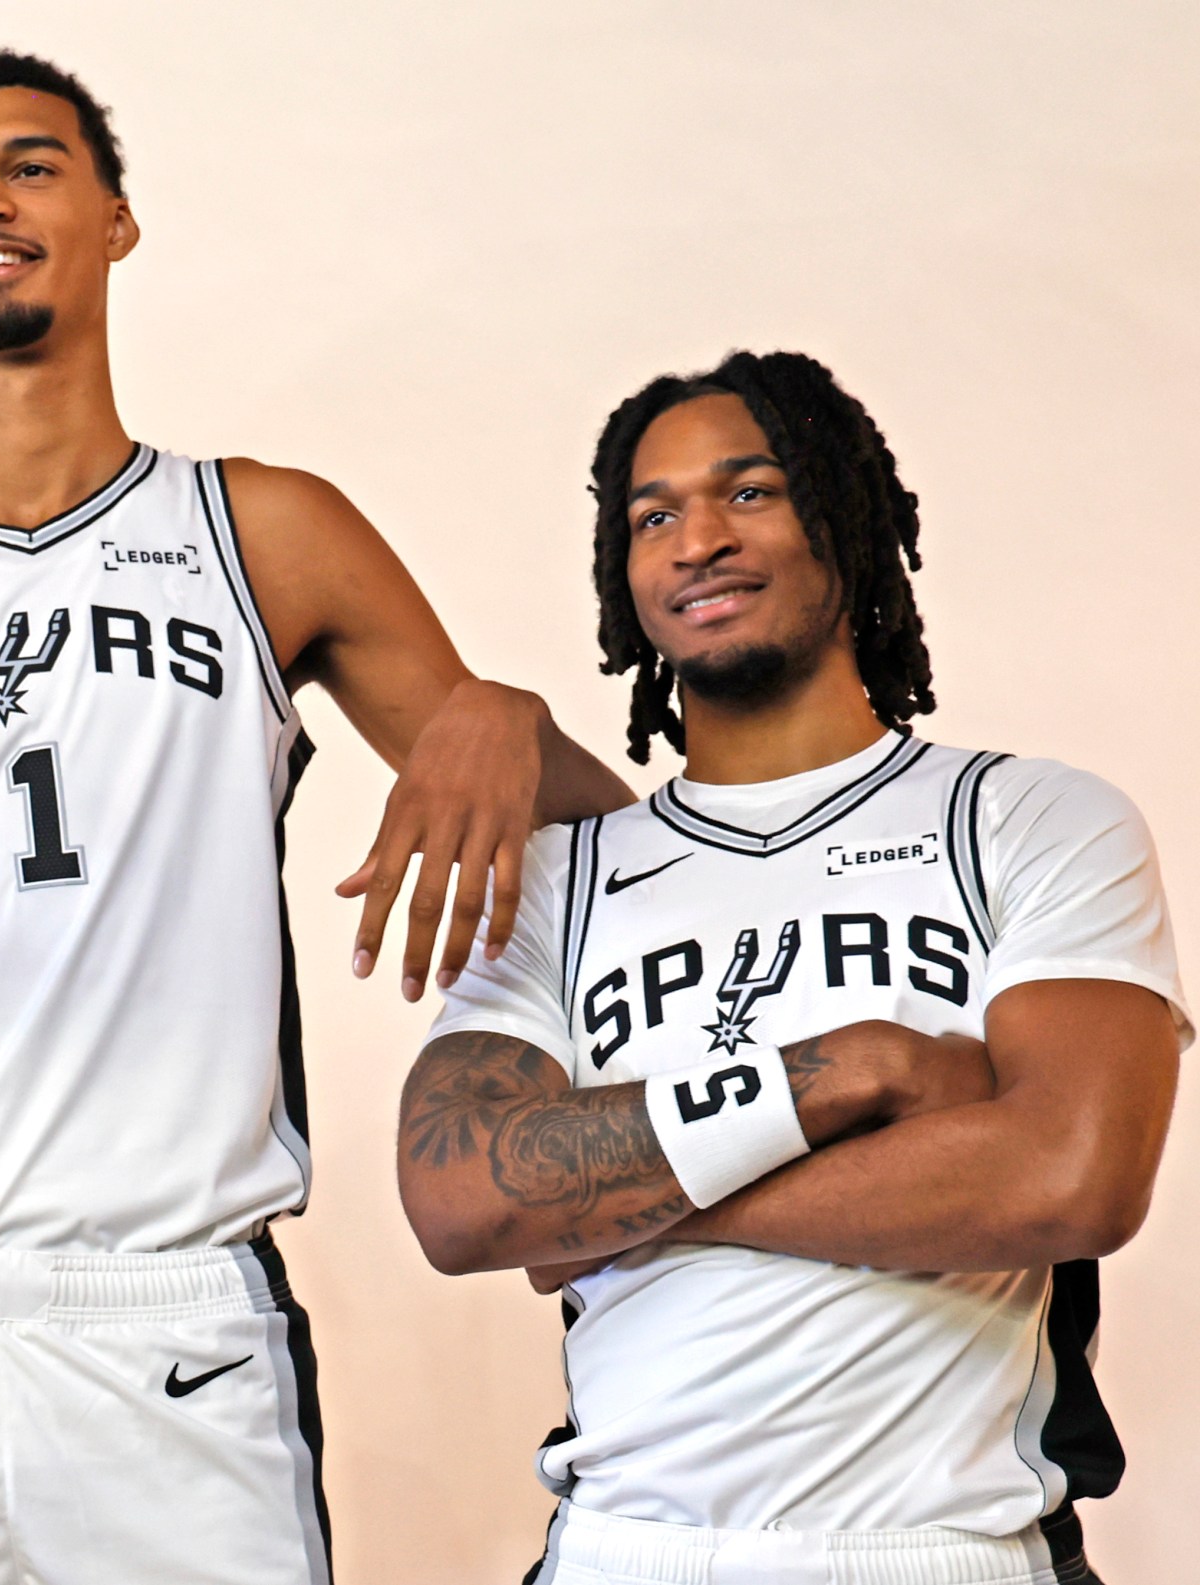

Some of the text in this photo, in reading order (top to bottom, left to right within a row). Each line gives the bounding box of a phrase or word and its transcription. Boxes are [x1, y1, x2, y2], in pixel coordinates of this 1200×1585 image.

[115, 549, 188, 565] LEDGER
[6, 741, 89, 892] 1
[841, 844, 924, 866] LEDGER
[583, 913, 969, 1070] SPURS
